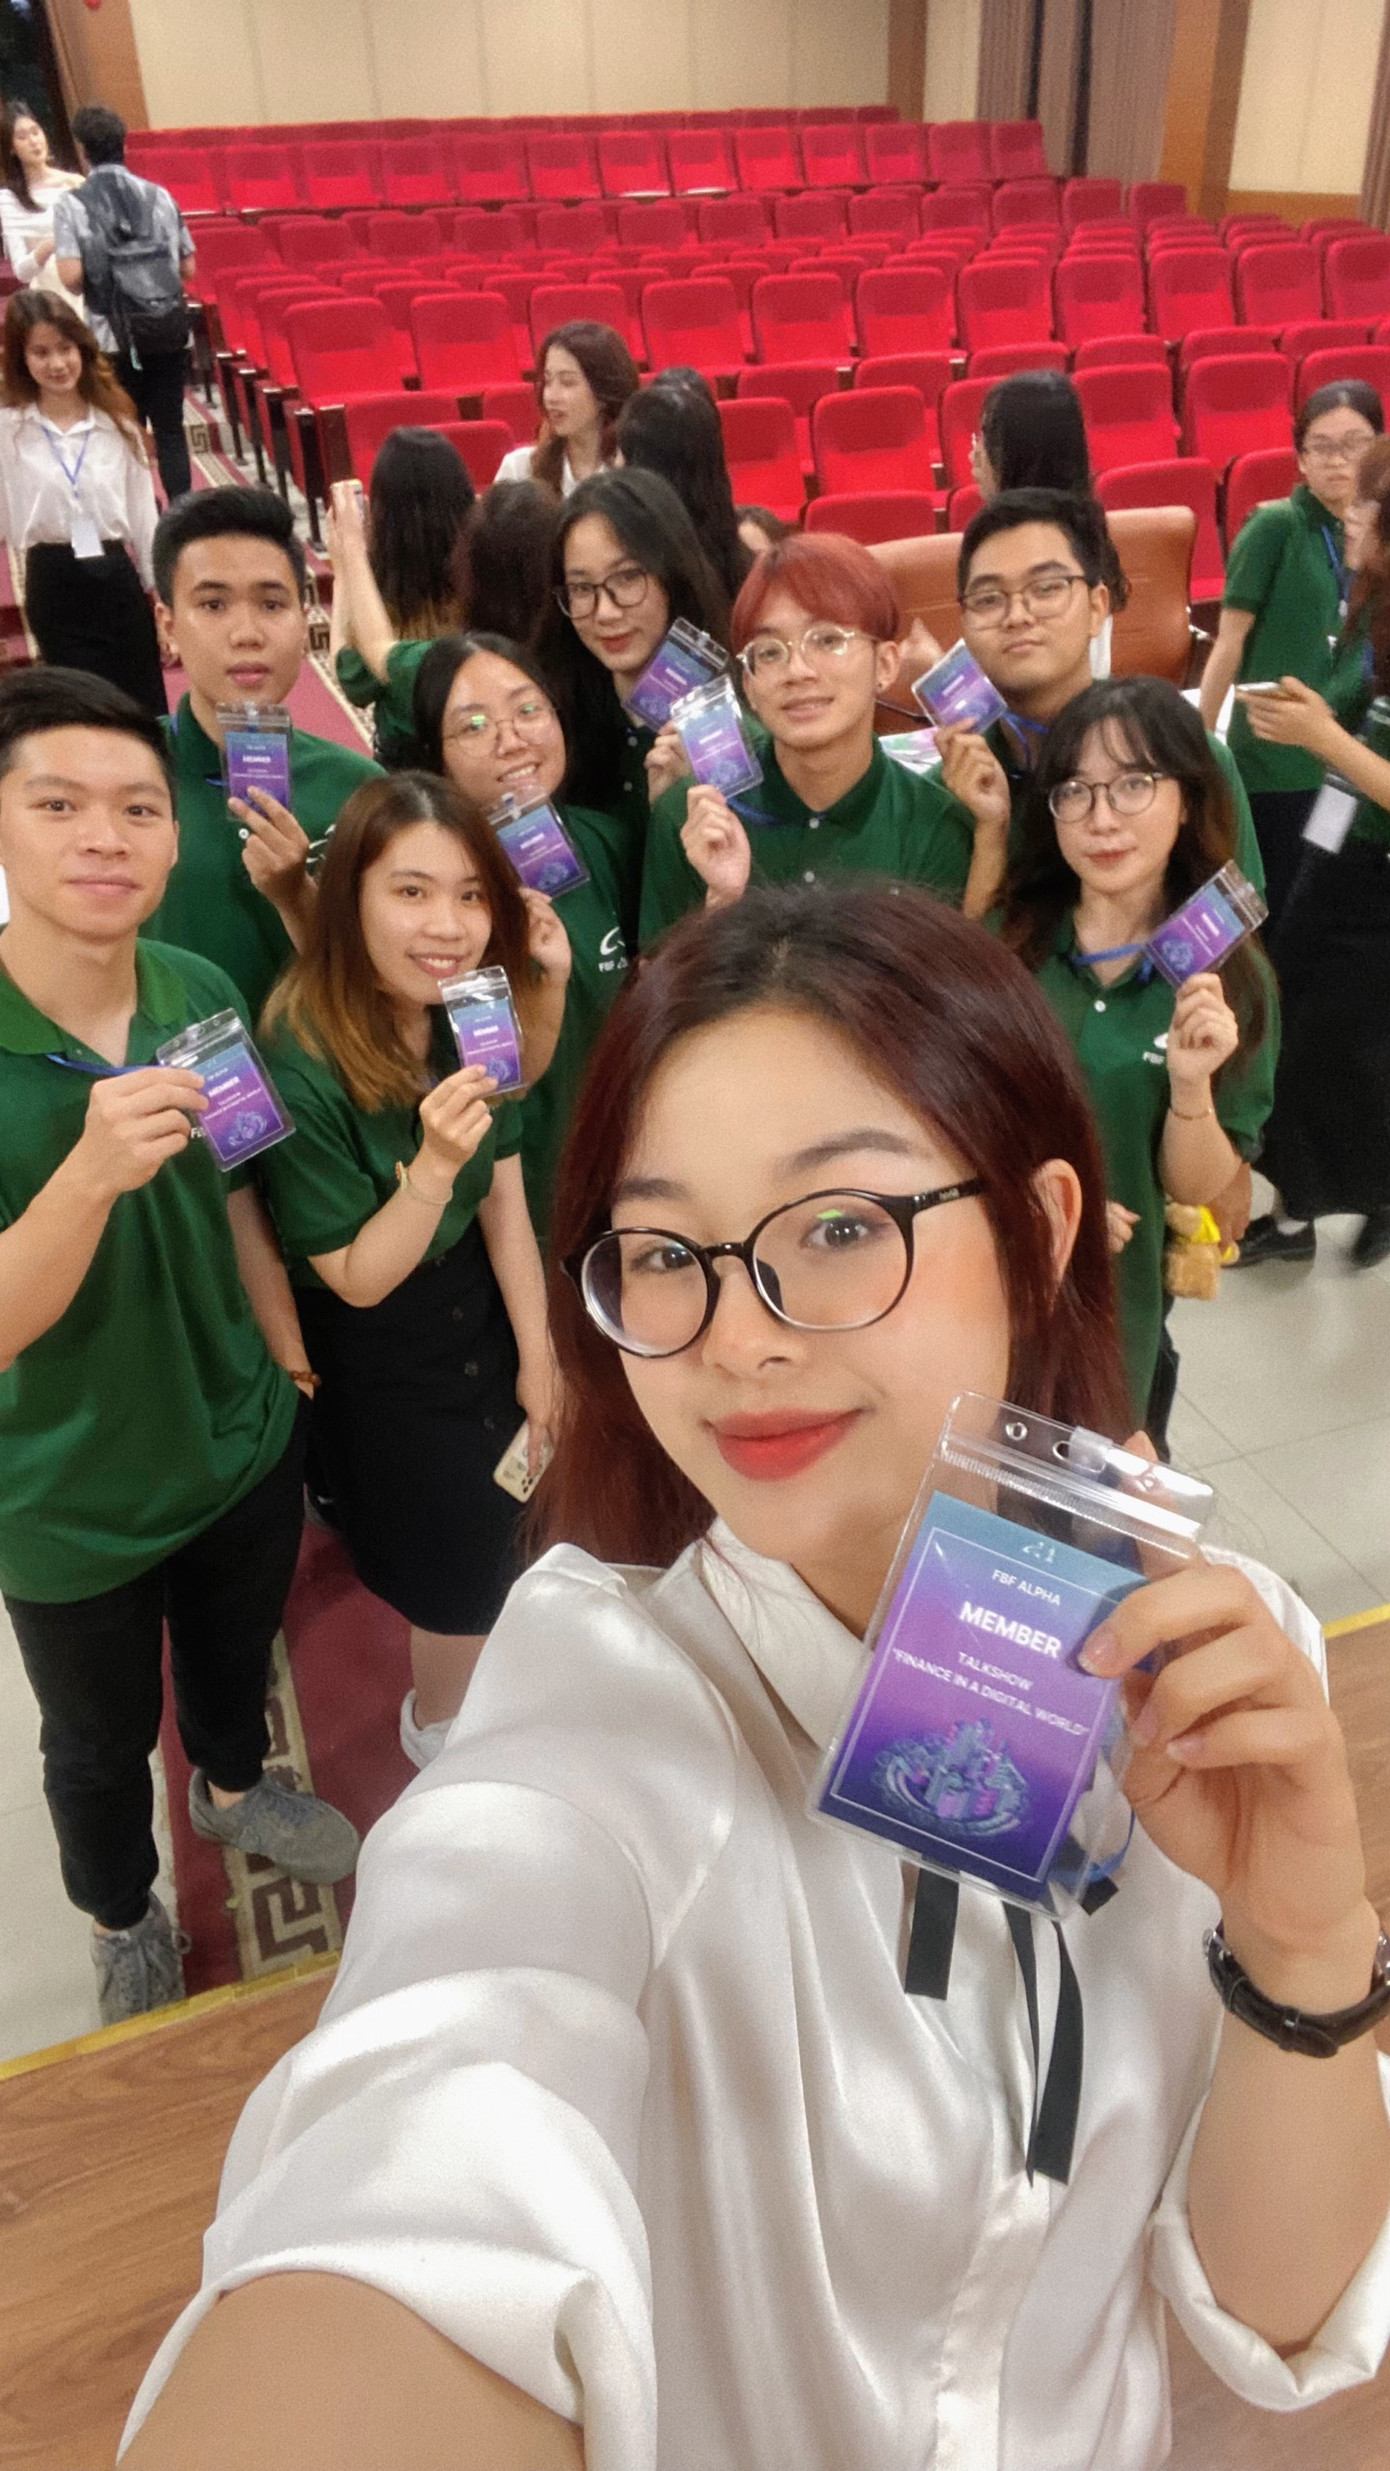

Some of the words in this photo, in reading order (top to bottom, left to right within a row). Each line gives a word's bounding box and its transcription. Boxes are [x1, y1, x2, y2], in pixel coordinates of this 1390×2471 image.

[992, 1569, 1017, 1586] FBF
[1017, 1581, 1061, 1605] ALPHA
[959, 1601, 1062, 1659] MEMBER
[959, 1652, 1033, 1690] TALKSHOW
[953, 1675, 969, 1689] IN
[969, 1680, 980, 1693] A
[980, 1685, 1033, 1716] DIGITAL
